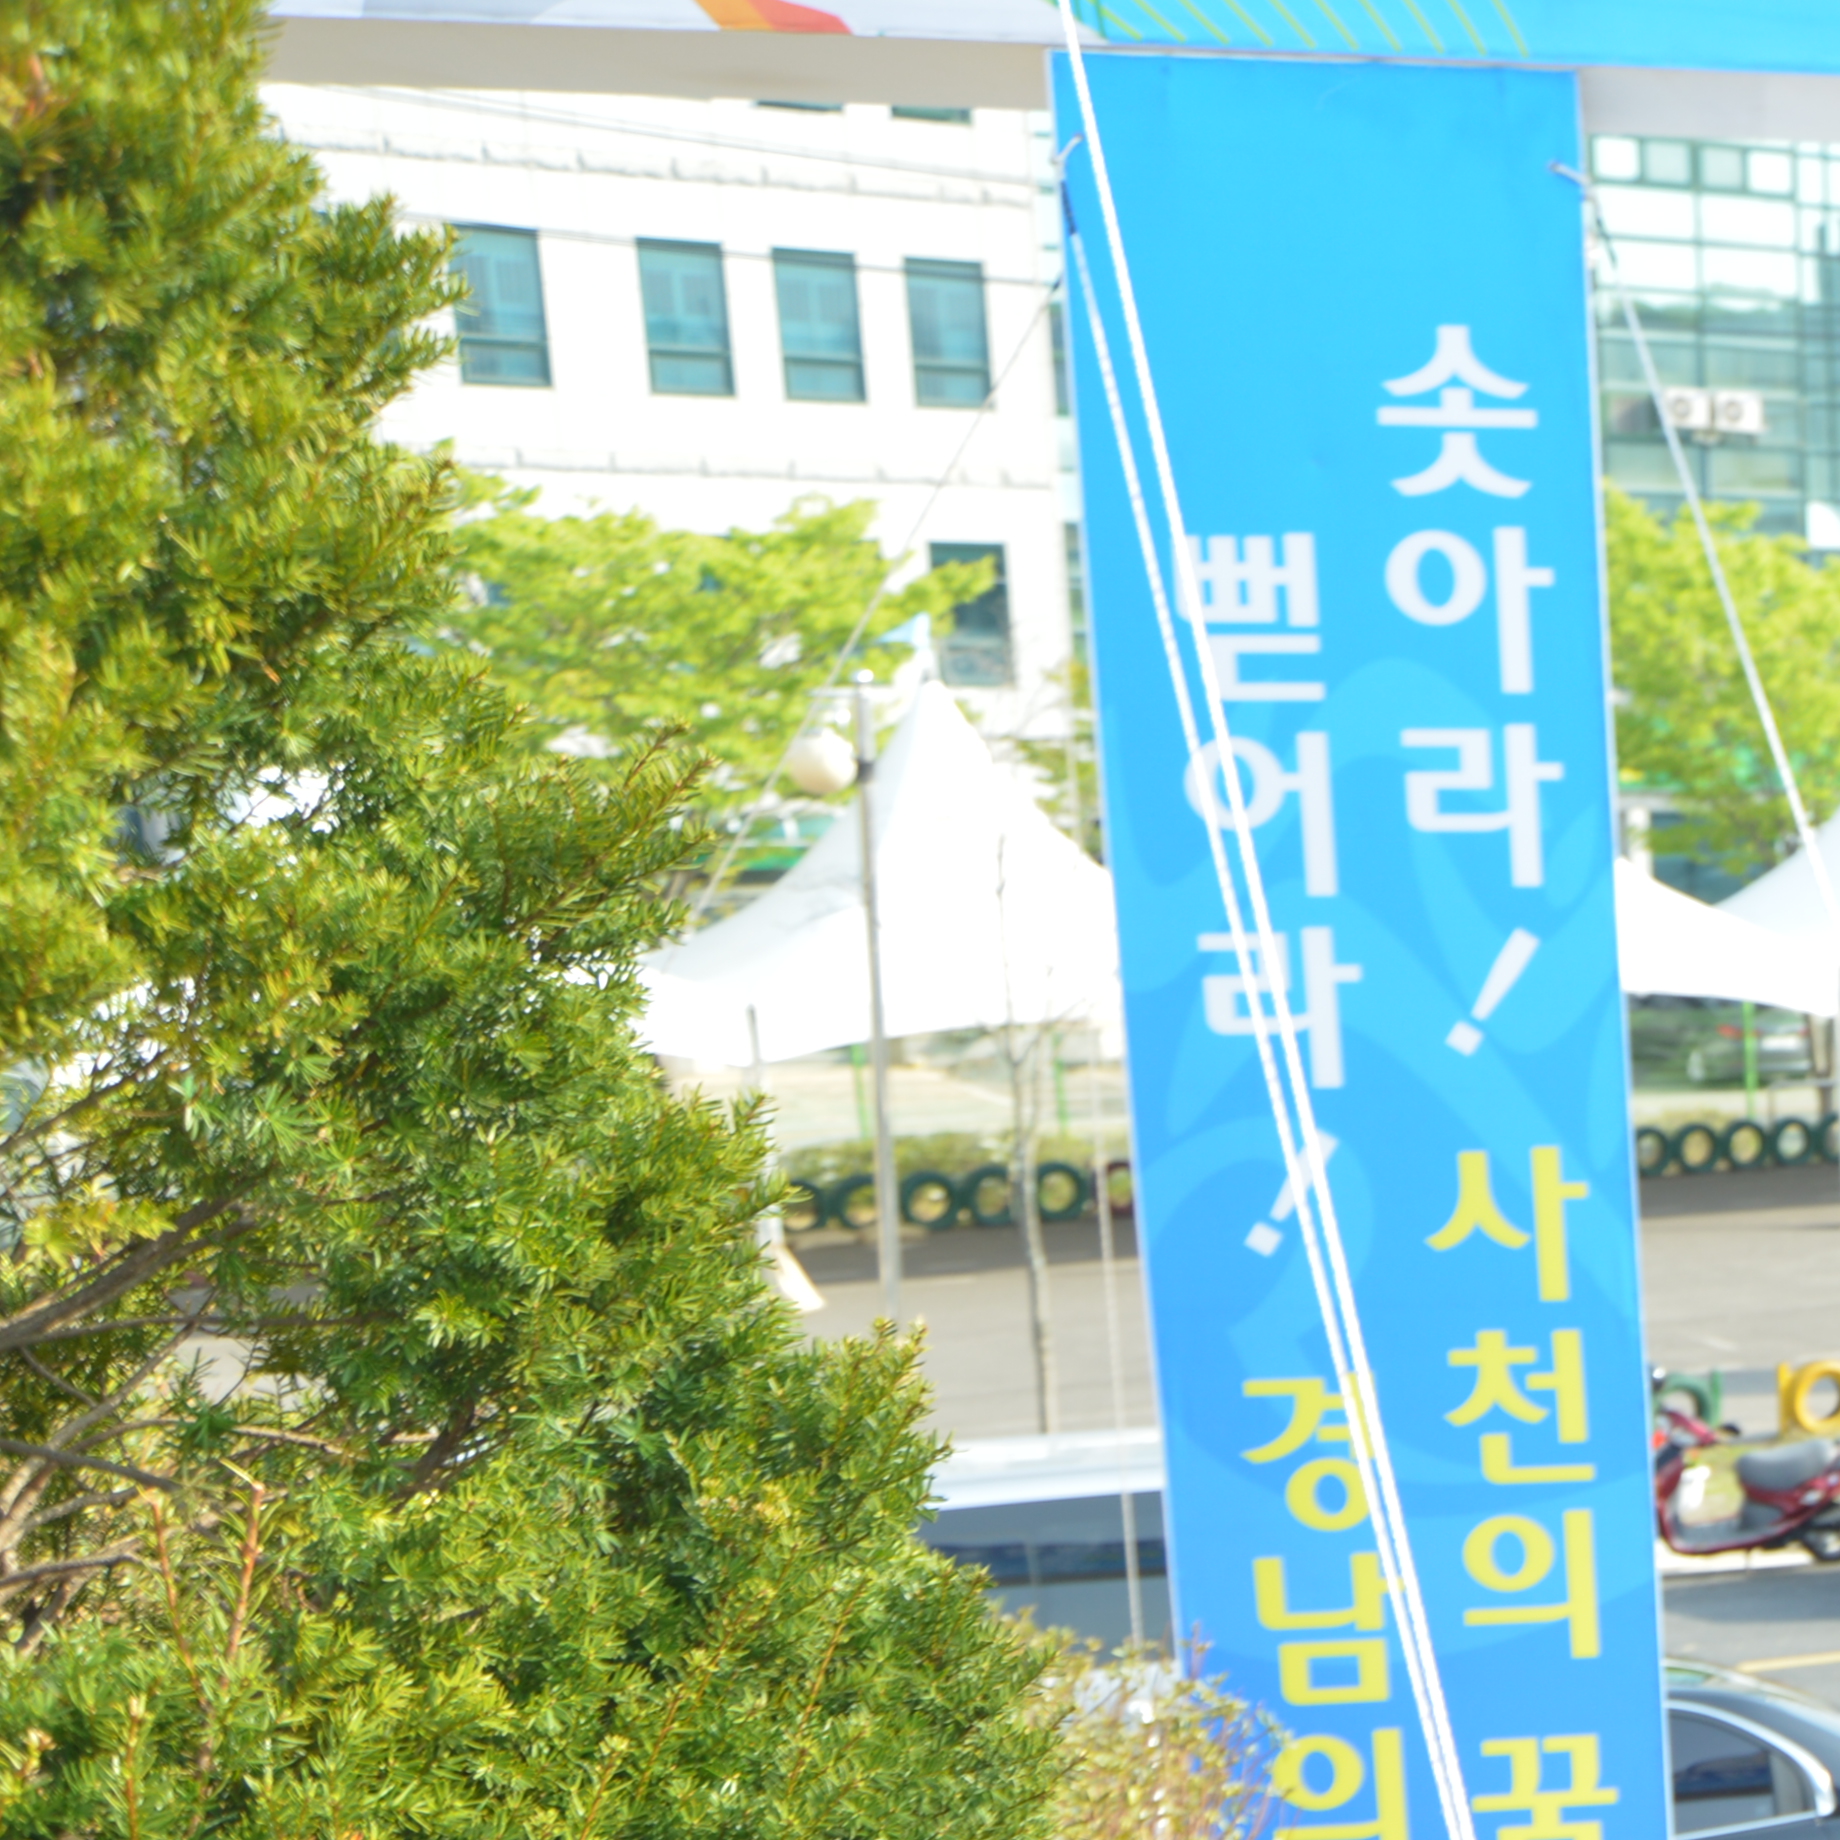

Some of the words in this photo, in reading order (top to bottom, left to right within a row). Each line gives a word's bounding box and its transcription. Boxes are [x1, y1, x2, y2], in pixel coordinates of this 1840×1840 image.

[1172, 531, 1362, 1257] 뻗어라!
[1377, 324, 1564, 1056] 솟아라!
[1424, 1145, 1601, 1658] 사천의
